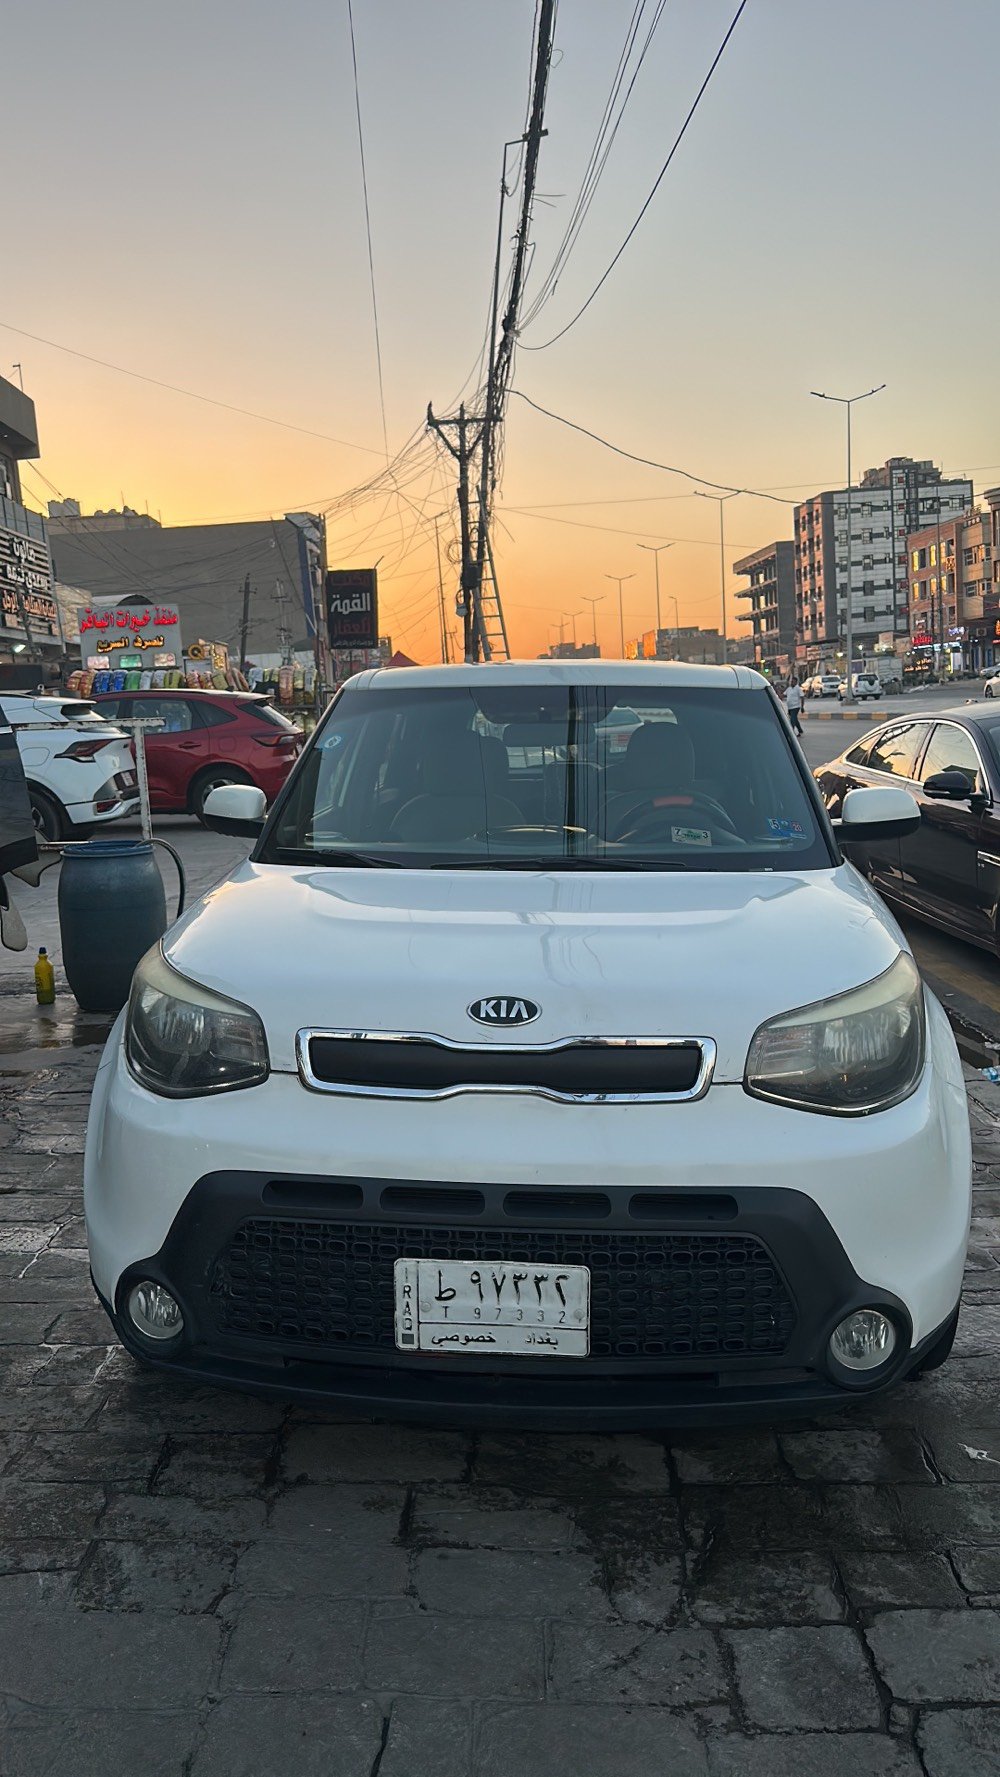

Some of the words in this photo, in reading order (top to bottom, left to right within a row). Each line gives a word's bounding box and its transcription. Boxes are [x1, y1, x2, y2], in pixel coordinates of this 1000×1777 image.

[331, 592, 371, 615] القمة
[80, 607, 114, 634] الباقر
[116, 608, 151, 632] خيرات
[153, 606, 178, 626] منفذ
[97, 637, 129, 653] السريع
[480, 1000, 529, 1019] KIA
[434, 1269, 457, 1302] ط
[402, 1267, 413, 1331] IRAQ
[442, 1305, 450, 1318] T
[431, 1332, 497, 1347] خصوصي
[524, 1332, 559, 1350] بغداد
